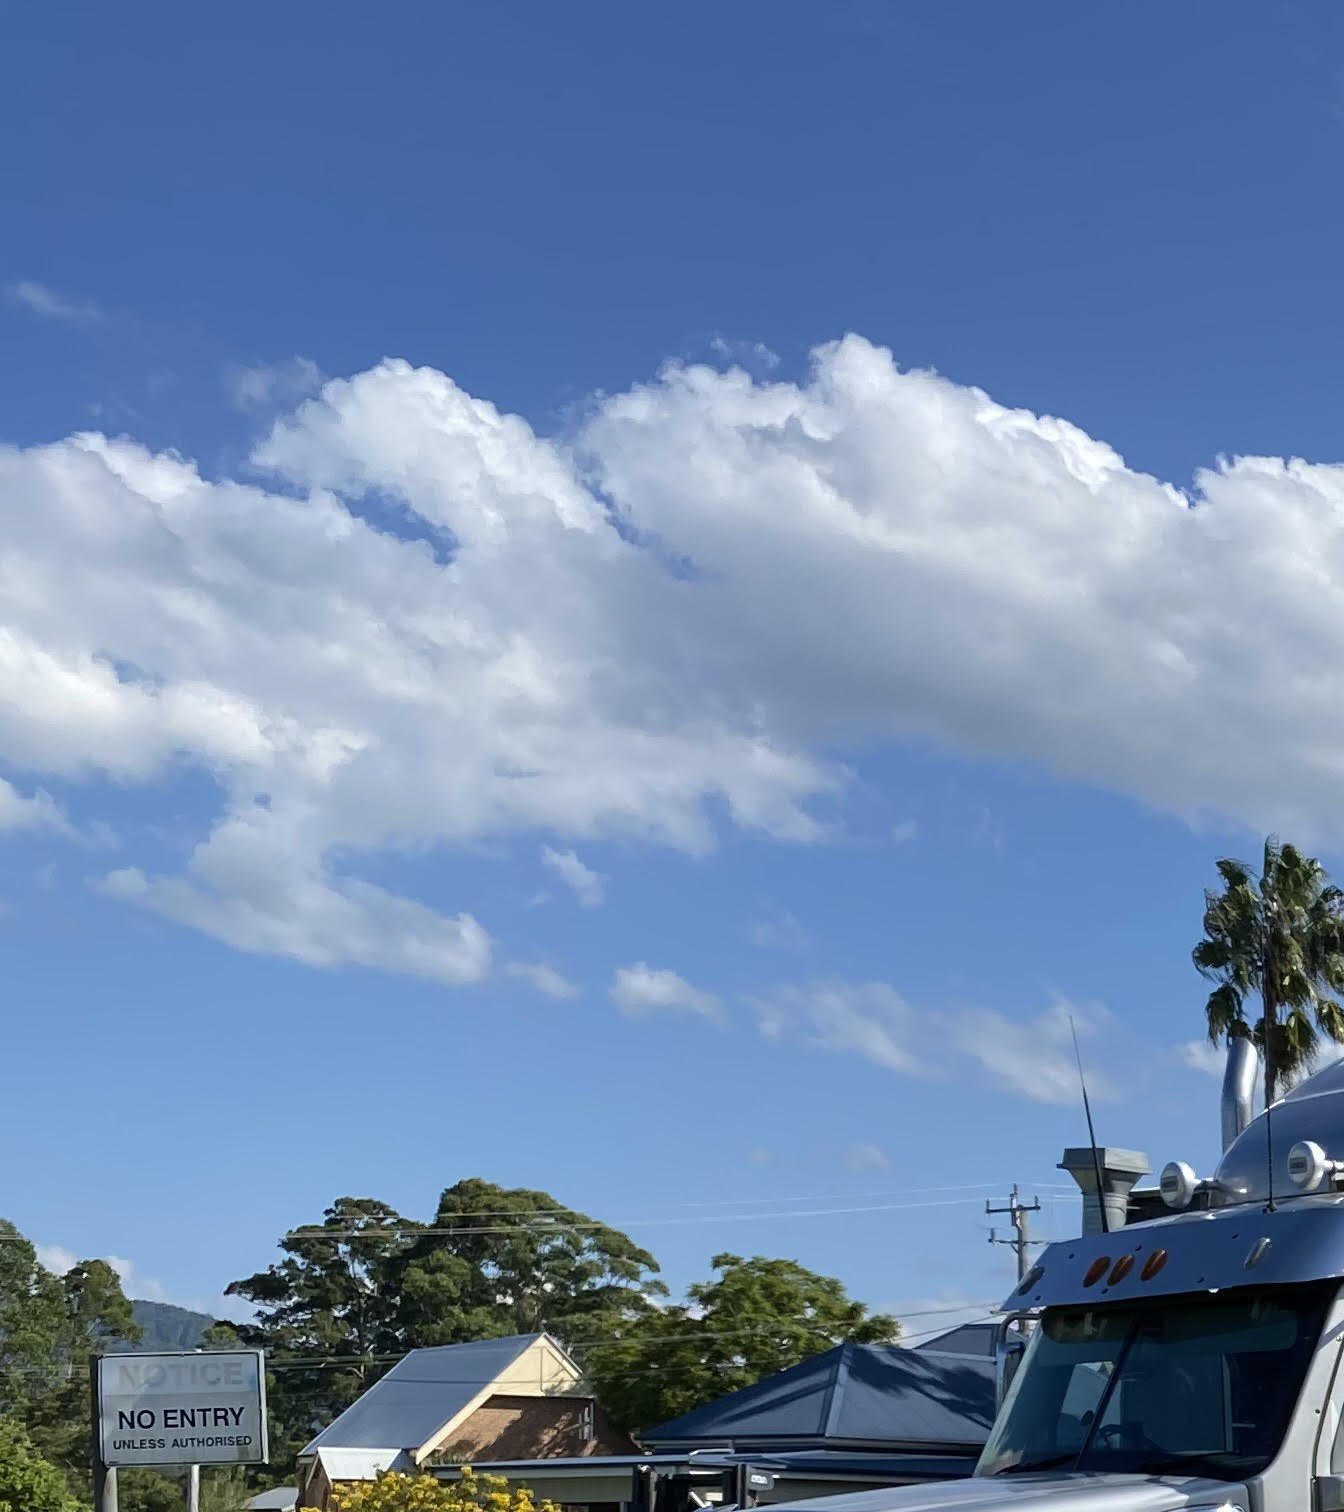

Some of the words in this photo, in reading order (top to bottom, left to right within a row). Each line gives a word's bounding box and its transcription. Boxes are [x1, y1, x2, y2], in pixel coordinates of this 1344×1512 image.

[118, 1362, 244, 1387] NOTICE
[118, 1410, 156, 1430] NO
[163, 1406, 245, 1428] ENTRY
[113, 1439, 166, 1450] UNLESS
[171, 1435, 253, 1448] AUTHORISED
